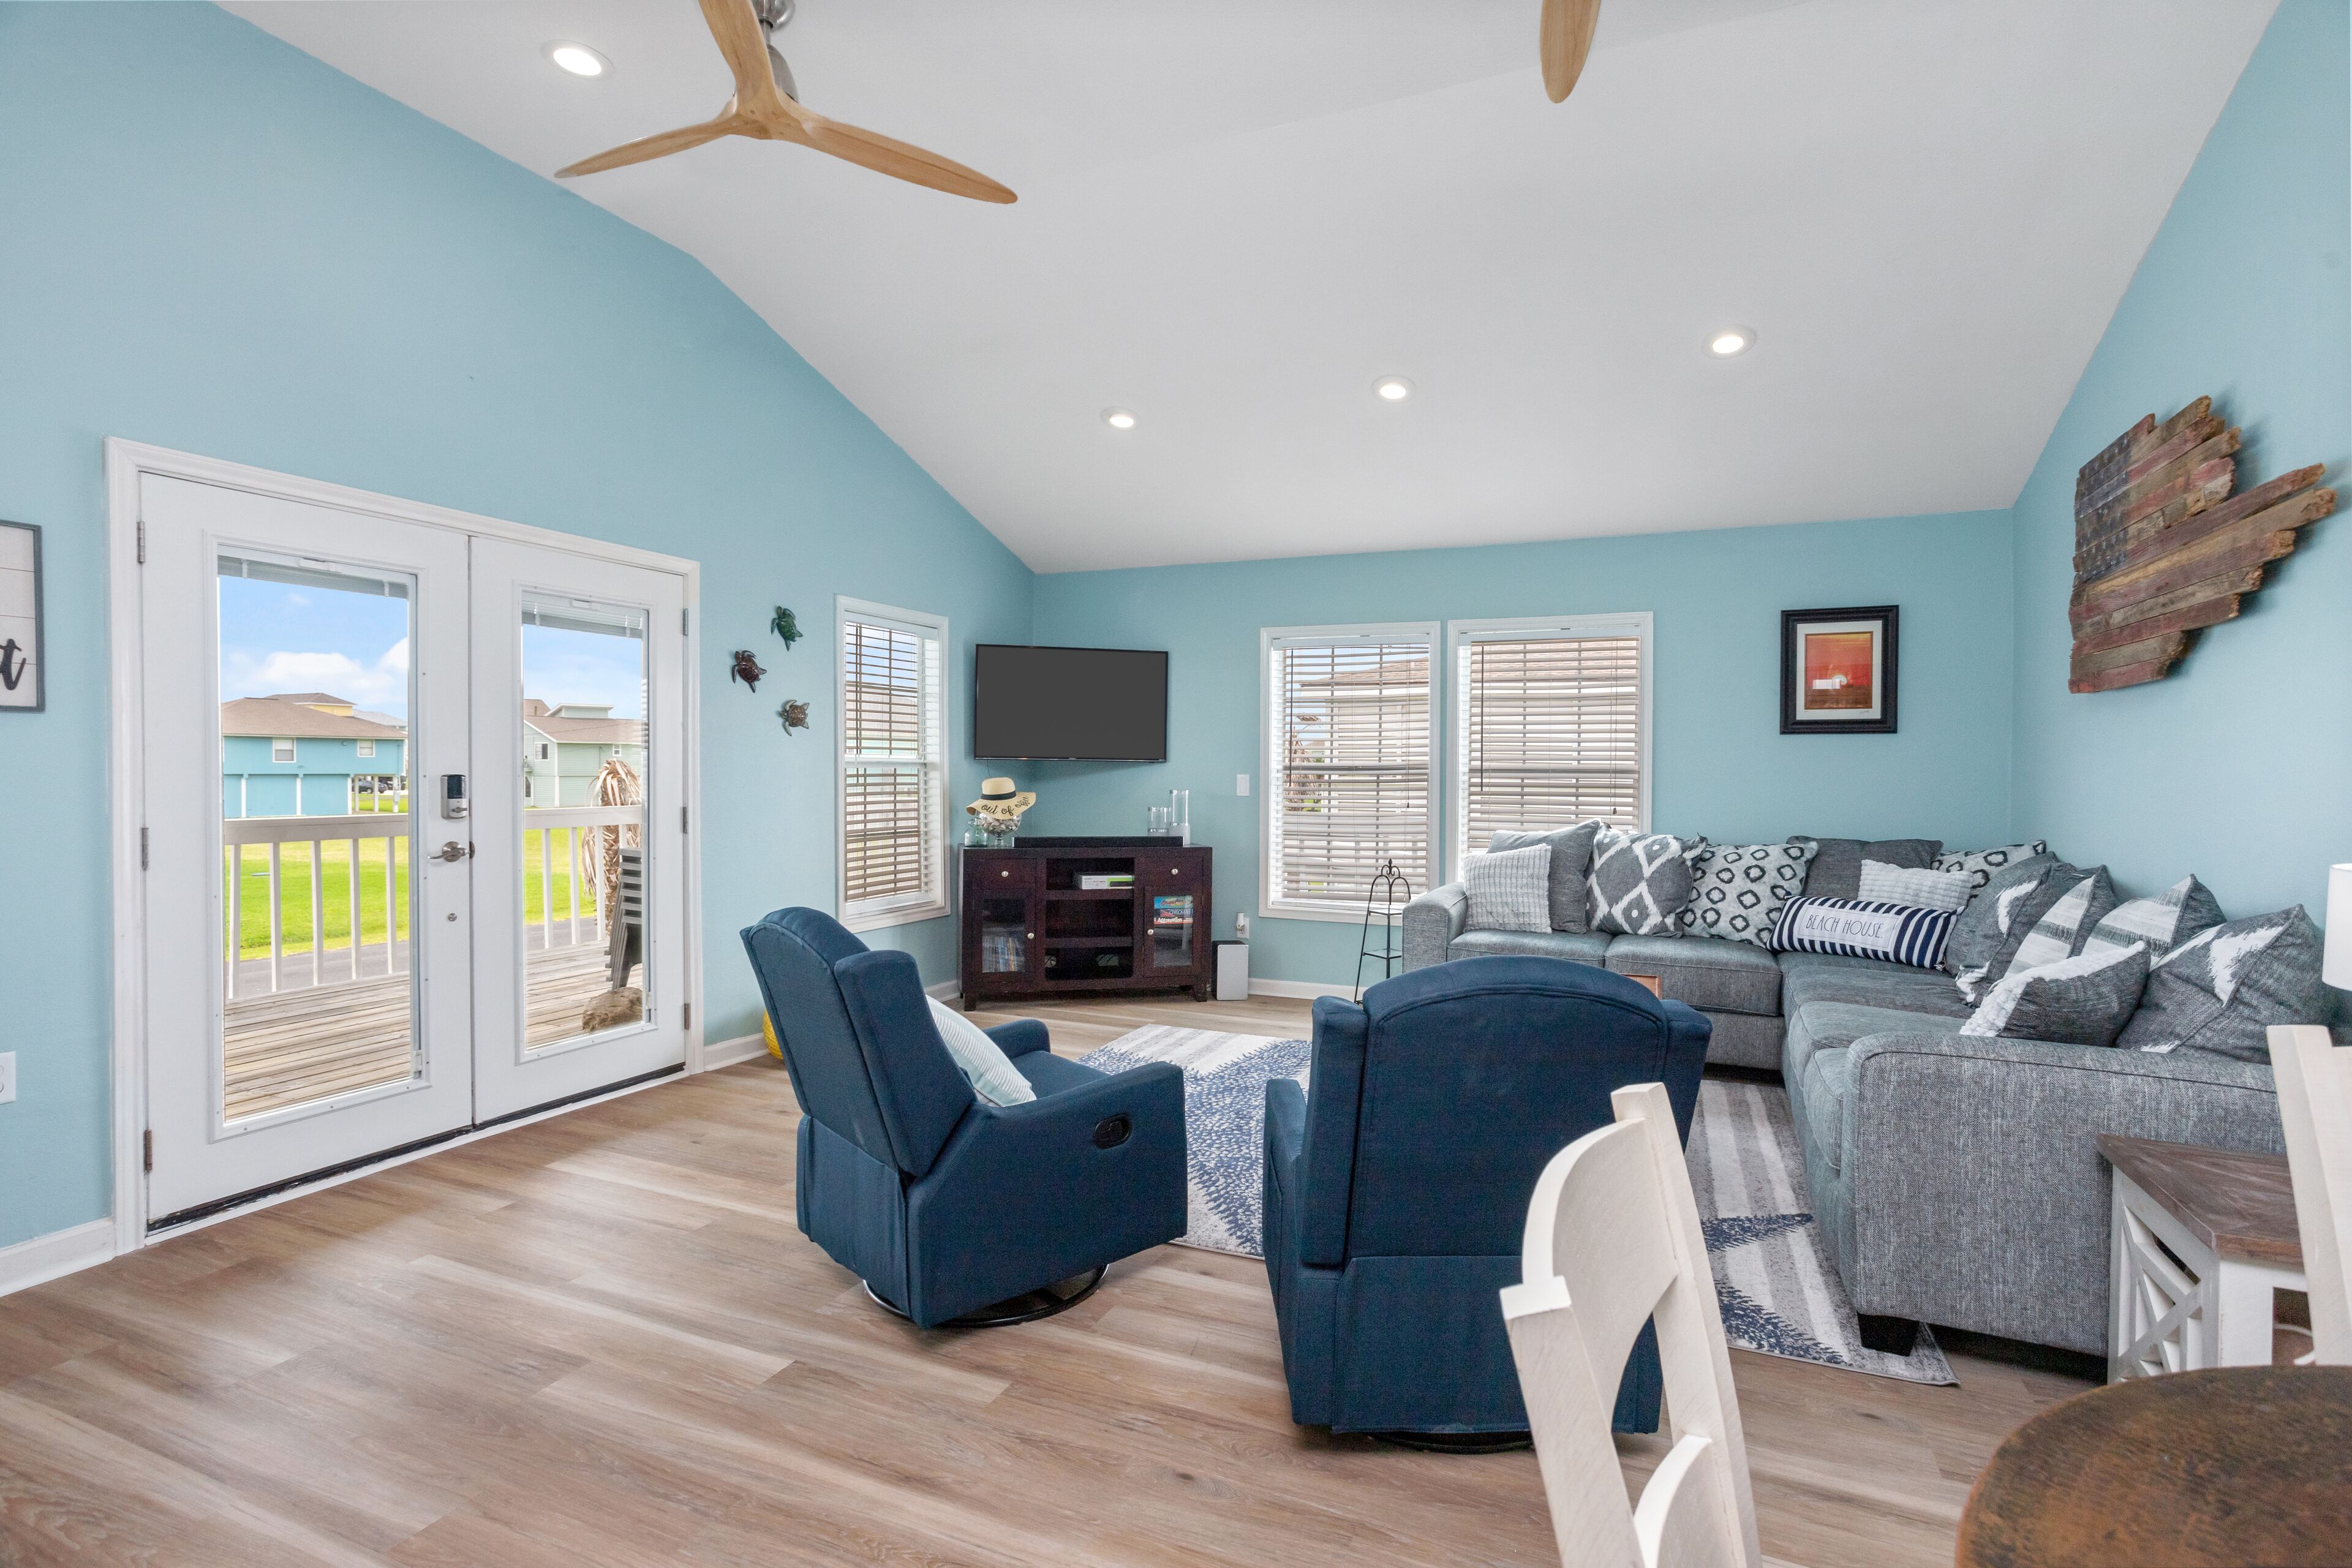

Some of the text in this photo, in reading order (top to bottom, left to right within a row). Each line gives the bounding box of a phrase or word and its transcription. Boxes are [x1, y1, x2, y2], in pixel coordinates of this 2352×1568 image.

[981, 804, 998, 814] out
[1001, 805, 1014, 816] of
[1806, 914, 1883, 938] BEACH HOUSE.
